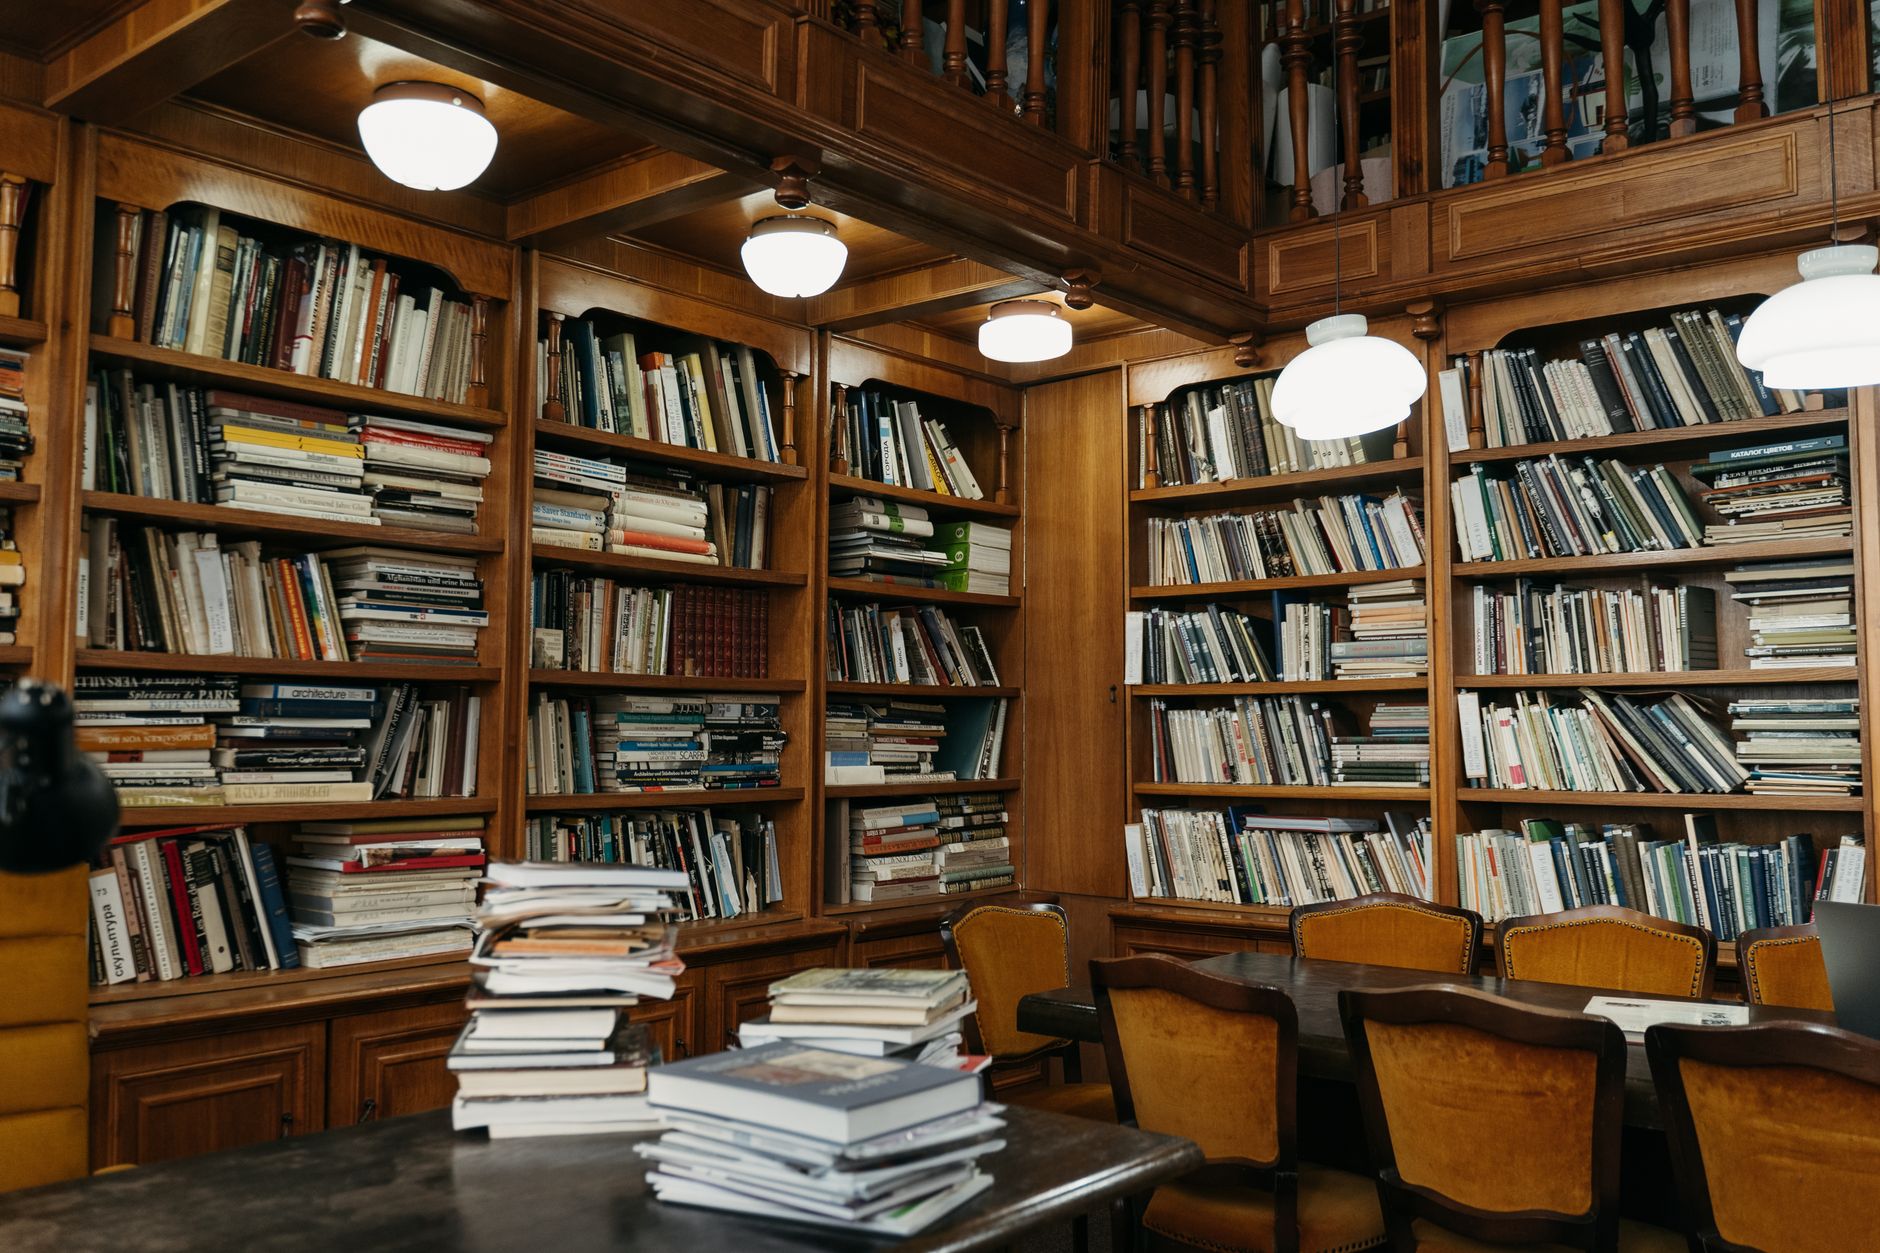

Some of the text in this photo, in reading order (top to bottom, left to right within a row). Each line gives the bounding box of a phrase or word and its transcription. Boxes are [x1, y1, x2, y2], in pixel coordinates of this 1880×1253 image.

[883, 440, 891, 477] ГОРОДА
[1730, 448, 1763, 459] КАТАЛОГ
[1762, 444, 1793, 455] ЦВЕТОВ
[927, 451, 943, 483] CATALOG
[559, 506, 592, 520] Standards
[386, 573, 427, 585] Afghanistan
[441, 578, 458, 586] seine
[459, 577, 478, 588] Kunst
[128, 689, 235, 701] Splendeurs de PARIS
[291, 687, 347, 699] architecture
[679, 751, 706, 760] SCARPA
[102, 903, 124, 978] скульптура
